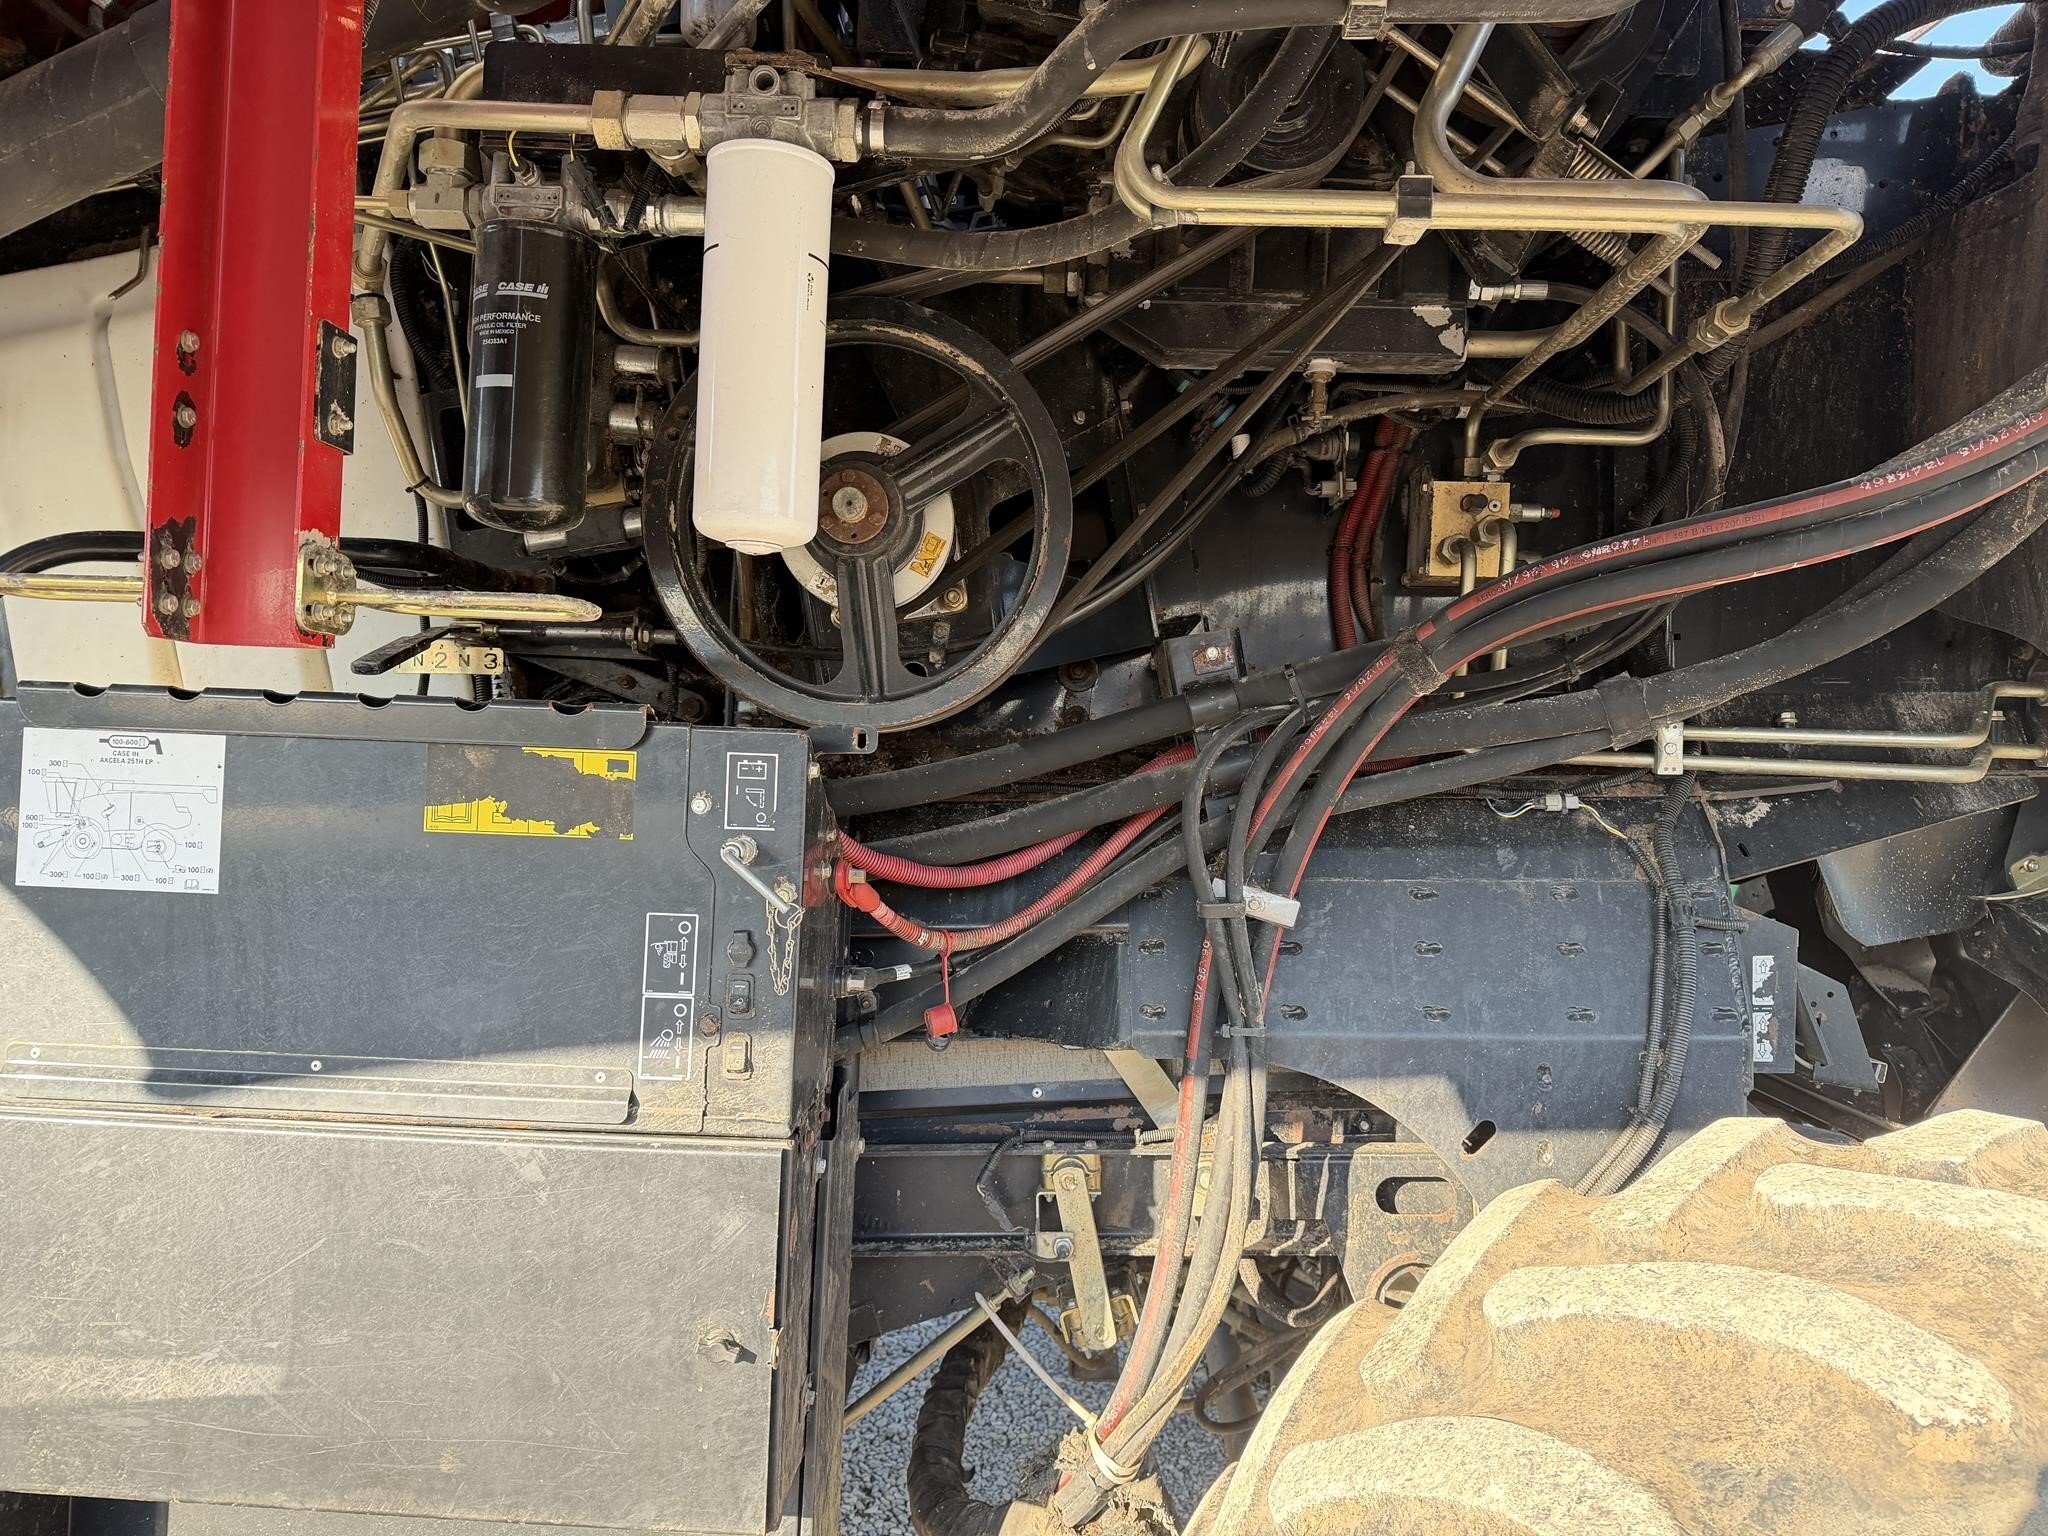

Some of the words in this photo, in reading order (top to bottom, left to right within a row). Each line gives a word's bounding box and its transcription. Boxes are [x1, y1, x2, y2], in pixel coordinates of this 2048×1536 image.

[498, 281, 535, 292] CASE
[480, 312, 541, 322] PERFORMANCE
[1691, 524, 1714, 536] BAR
[435, 652, 447, 668] 2
[459, 654, 470, 667] N
[484, 653, 498, 669] 3
[187, 866, 200, 874] 100
[120, 874, 134, 882] 300
